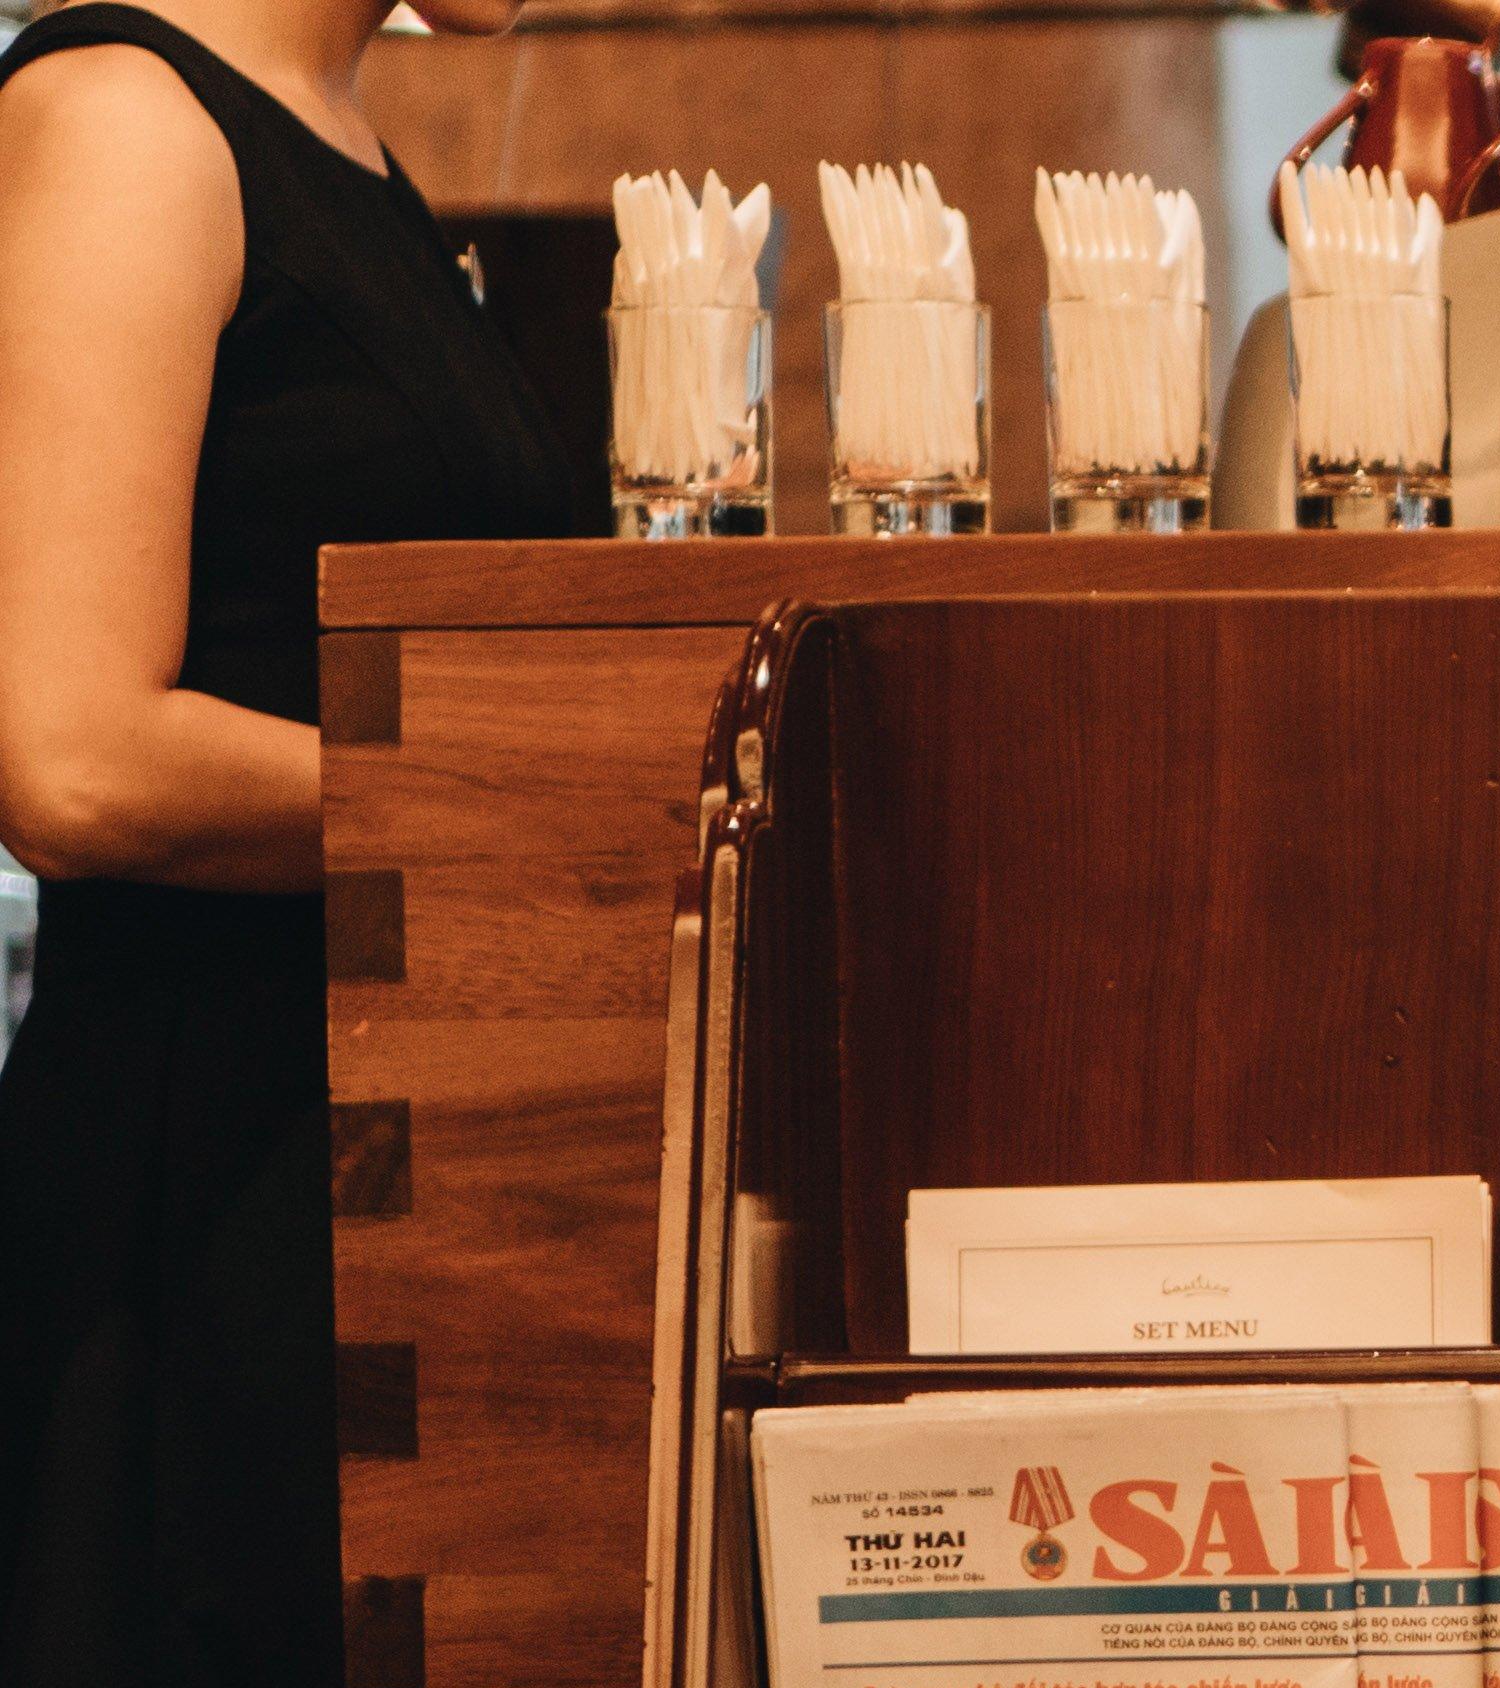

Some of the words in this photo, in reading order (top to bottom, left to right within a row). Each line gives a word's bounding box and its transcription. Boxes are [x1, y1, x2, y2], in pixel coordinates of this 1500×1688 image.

[1133, 1321, 1178, 1340] SET
[1185, 1319, 1259, 1338] MENU
[886, 1505, 943, 1517] 14534
[845, 1531, 904, 1552] THỨ
[914, 1530, 966, 1549] HAI
[850, 1554, 964, 1571] 13-11-2017
[1125, 1623, 1162, 1634] QUAN
